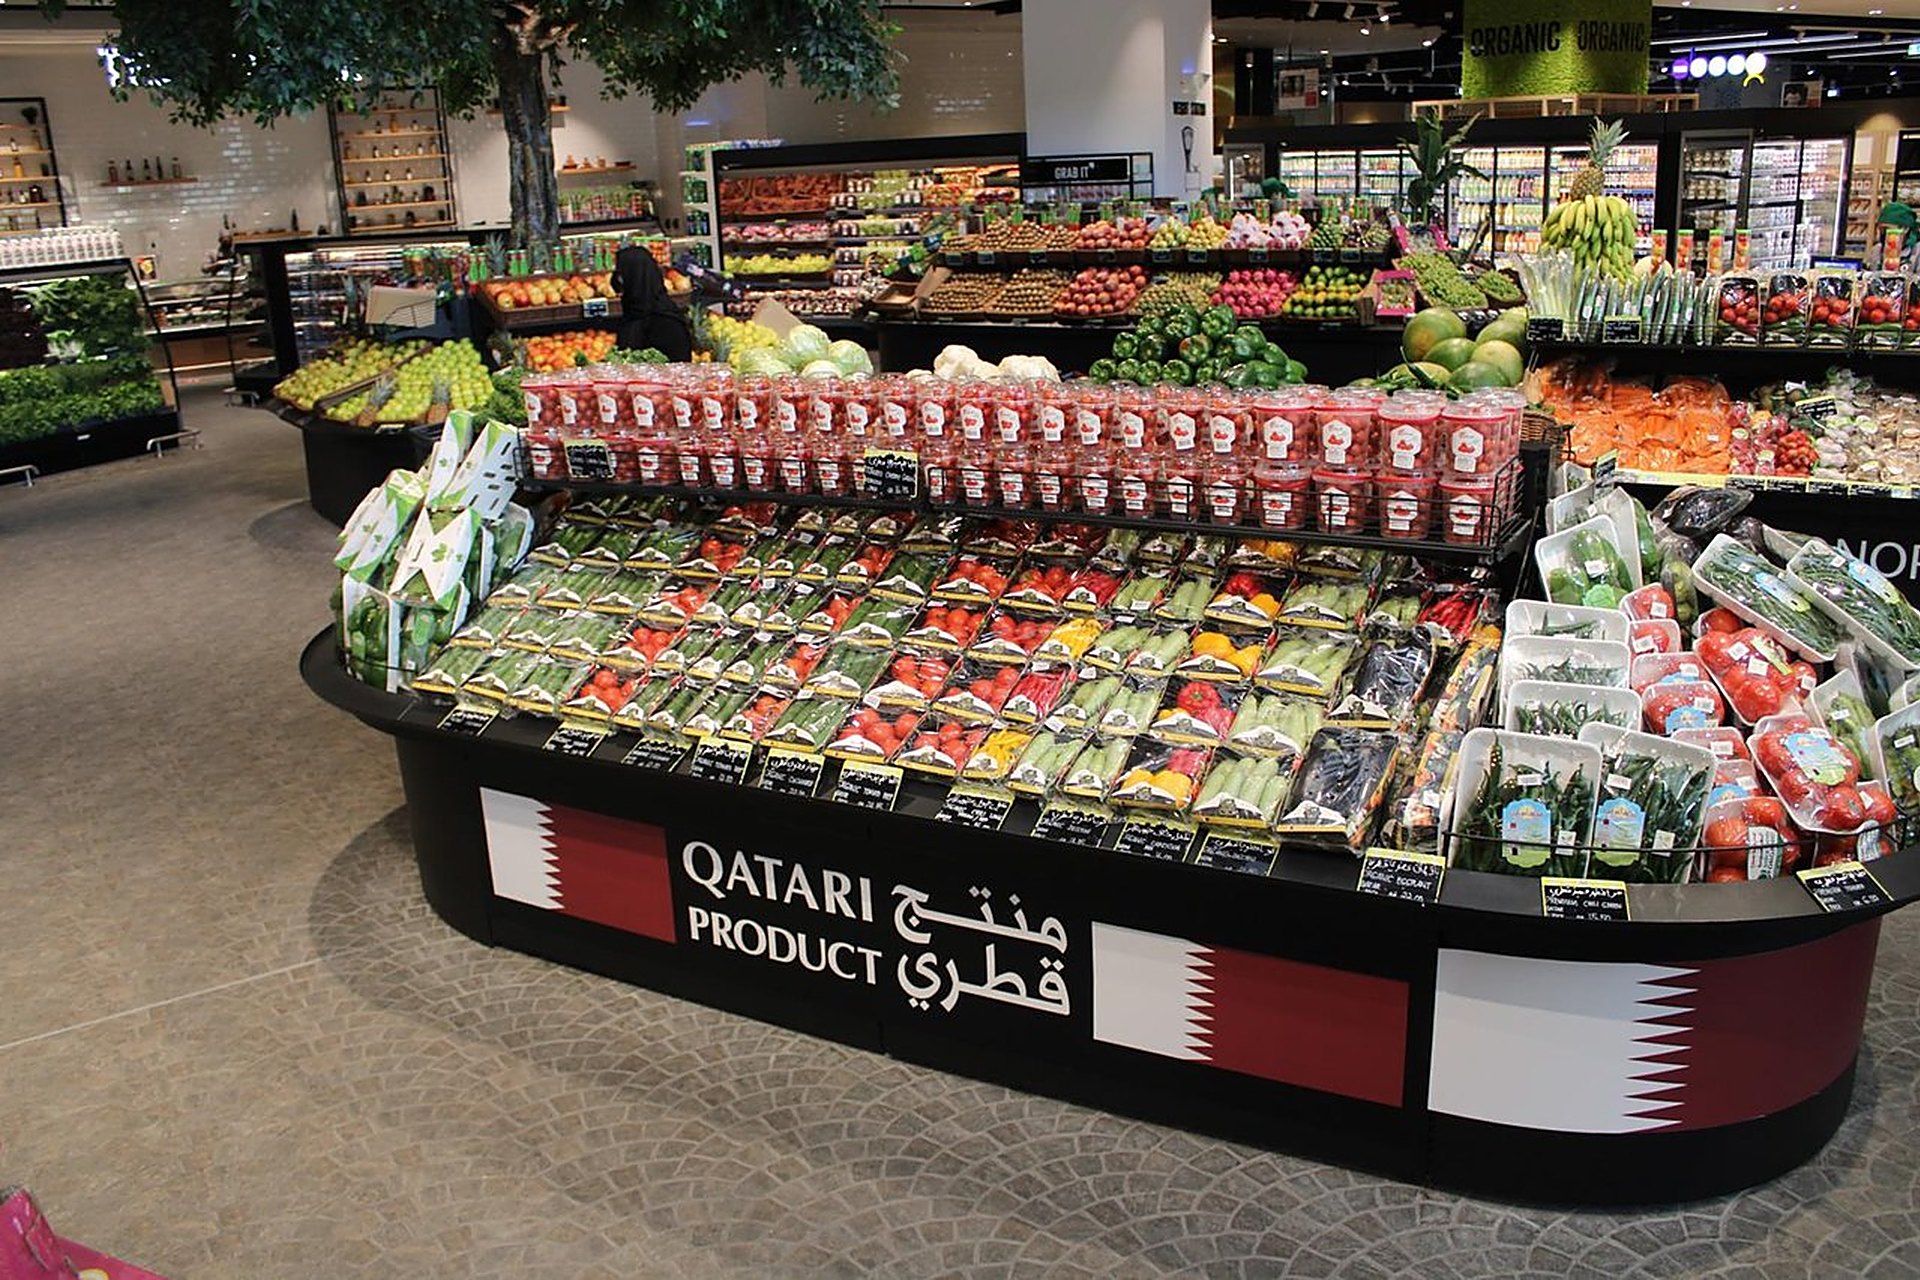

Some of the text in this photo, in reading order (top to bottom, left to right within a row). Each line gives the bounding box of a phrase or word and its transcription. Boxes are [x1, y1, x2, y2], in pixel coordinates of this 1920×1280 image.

[1470, 20, 1561, 57] ORGANIC
[1577, 20, 1646, 53] ORGANIC
[1055, 166, 1089, 179] GRAB IT
[682, 840, 874, 923] QATARI
[891, 881, 1069, 955] منتج
[687, 905, 883, 986] PRODUCT
[897, 942, 1072, 1016] قطري
